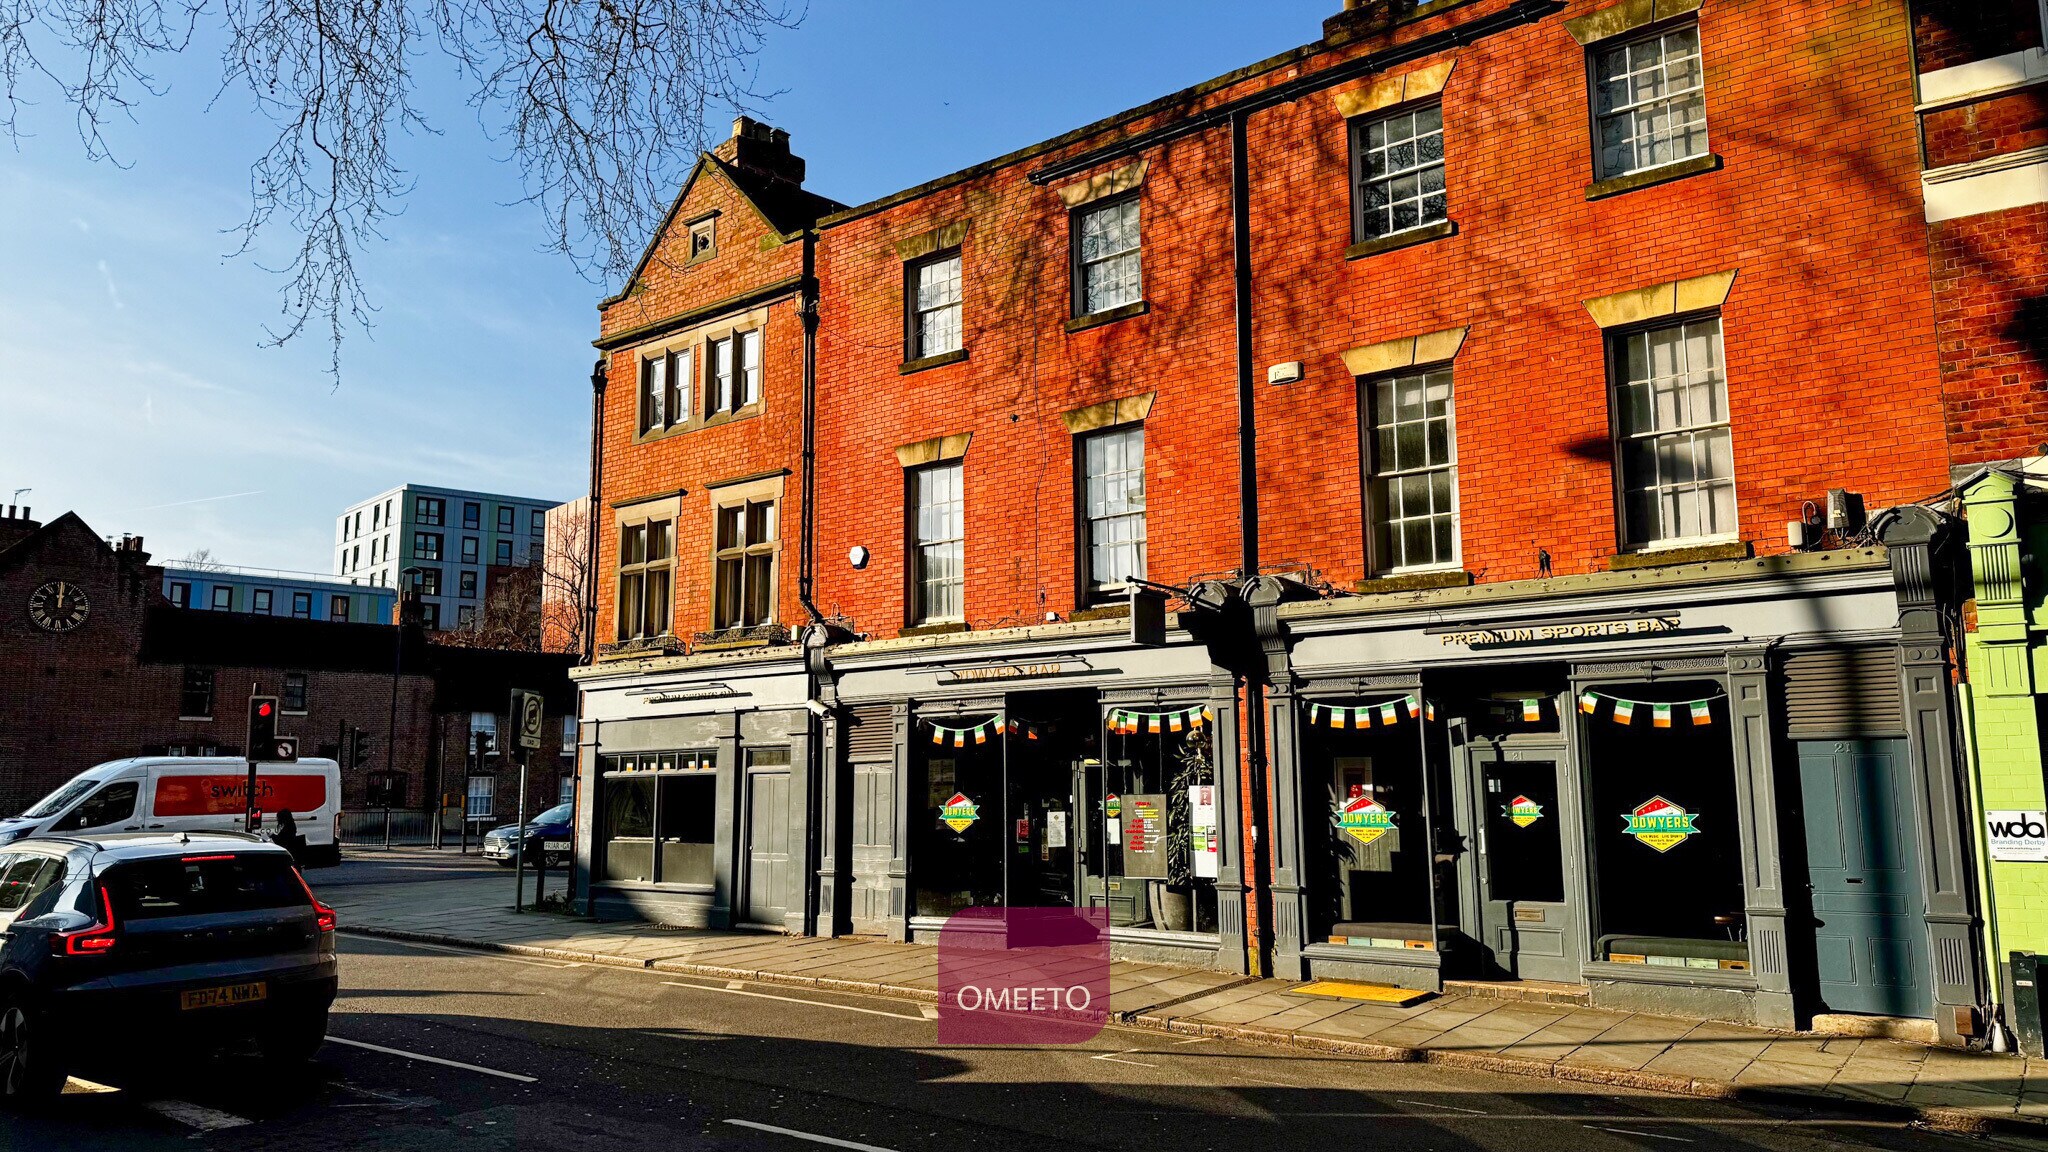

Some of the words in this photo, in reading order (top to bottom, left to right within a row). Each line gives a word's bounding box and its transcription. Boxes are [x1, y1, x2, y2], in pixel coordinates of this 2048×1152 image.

[1441, 629, 1533, 646] PREMIUM
[1540, 621, 1629, 639] SPORTS
[1634, 618, 1681, 633] BAR
[1834, 742, 1852, 753] 21
[1343, 813, 1389, 824] ODWYERS
[1631, 816, 1690, 829] ODWYERS
[1988, 813, 2045, 838] wda
[188, 988, 228, 1006] FD74
